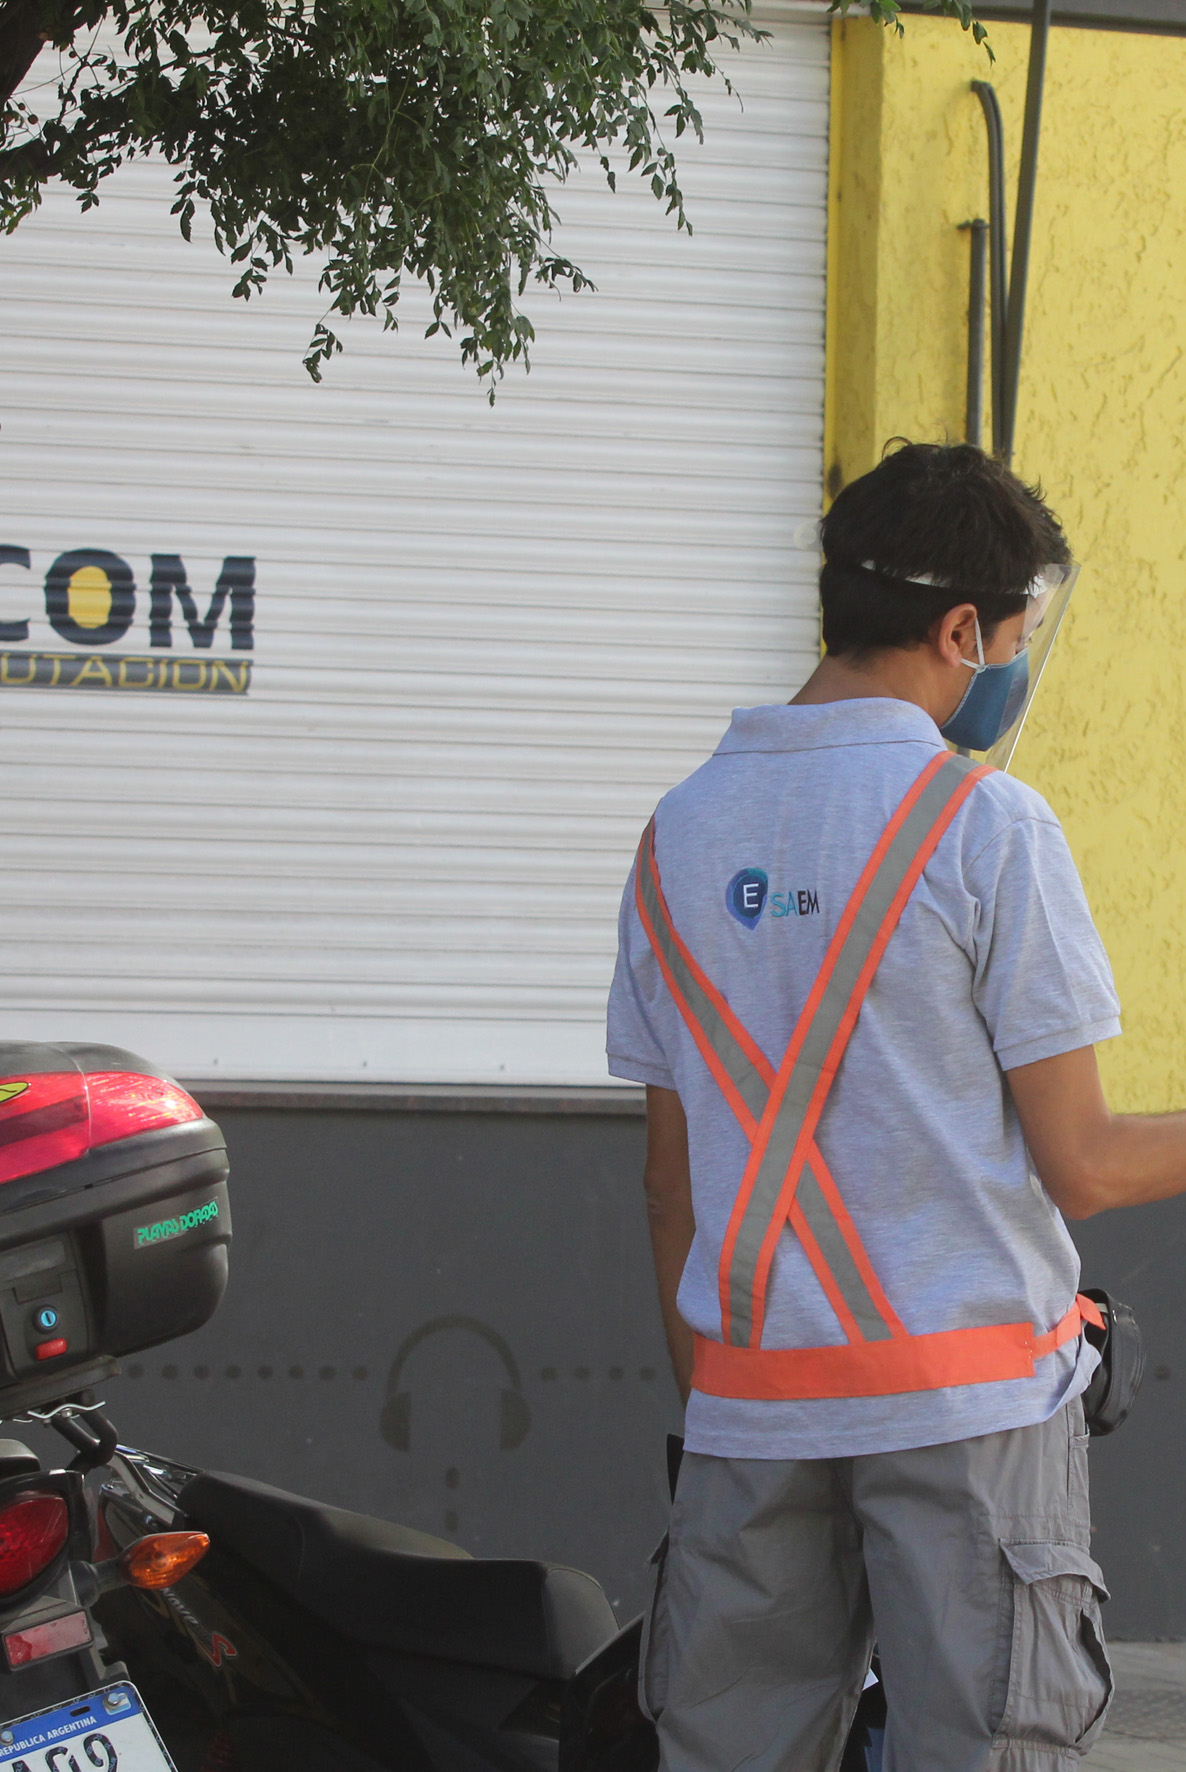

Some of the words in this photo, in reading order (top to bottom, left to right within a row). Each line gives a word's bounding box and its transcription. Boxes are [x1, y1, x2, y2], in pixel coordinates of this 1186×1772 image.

[743, 883, 760, 908] E
[770, 888, 820, 918] SAEM
[47, 1716, 97, 1740] ARGENTINA
